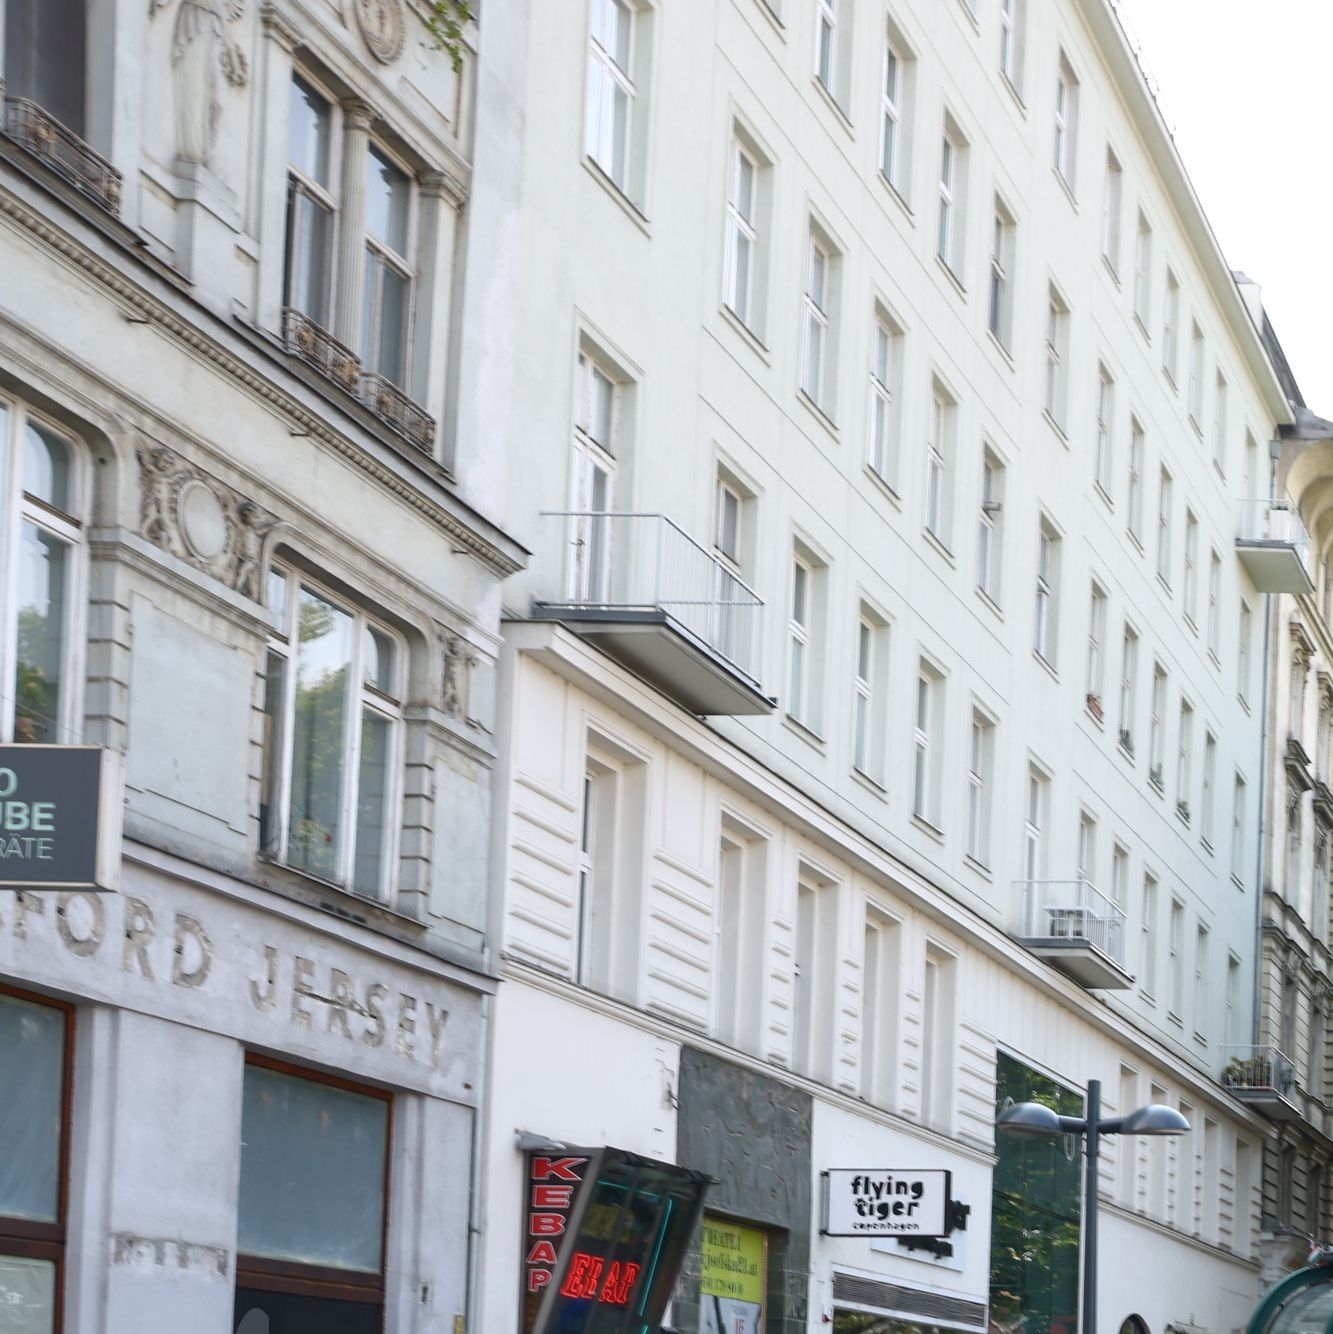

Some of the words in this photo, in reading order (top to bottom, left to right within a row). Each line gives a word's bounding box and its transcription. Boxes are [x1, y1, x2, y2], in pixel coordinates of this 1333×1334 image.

[249, 945, 449, 1071] JERSEY
[851, 1175, 924, 1200] flying
[855, 1197, 920, 1221] tiger
[526, 1156, 588, 1293] KEBAP
[852, 1222, 920, 1232] copenhagen
